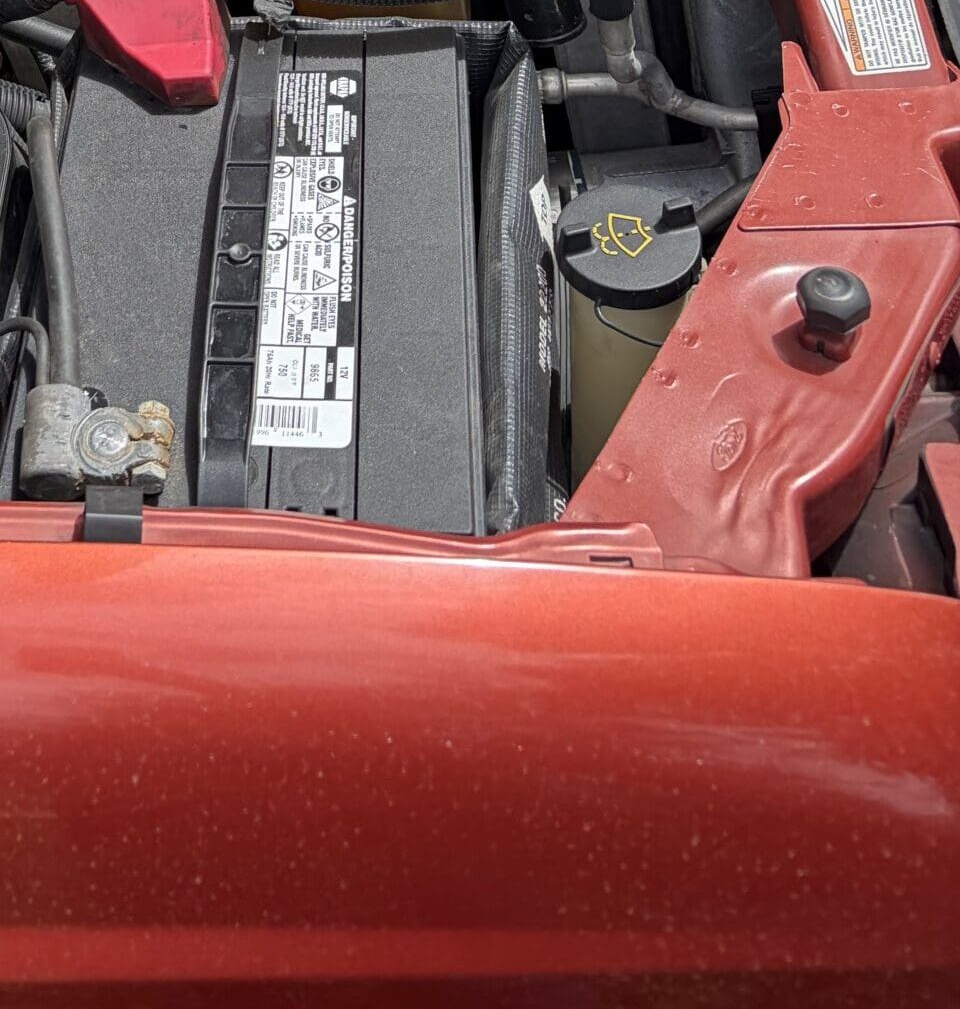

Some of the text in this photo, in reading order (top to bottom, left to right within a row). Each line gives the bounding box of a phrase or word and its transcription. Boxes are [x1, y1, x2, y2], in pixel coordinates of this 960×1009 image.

[845, 17, 860, 53] WARNING
[338, 77, 349, 97] NAPA
[308, 159, 316, 183] EXPLOSIVE
[323, 245, 331, 269] SULFURIC
[341, 207, 355, 302] DANGER/POISON
[319, 296, 327, 332] IMMEDIATELY
[328, 296, 336, 313] FLUSH
[287, 314, 296, 343] HELP FAST.
[295, 319, 303, 343] MEDICAL
[303, 334, 311, 344] GET
[534, 315, 551, 373] MODEL
[278, 364, 288, 377] 750
[310, 364, 319, 382] 9865
[340, 367, 348, 379] 12V
